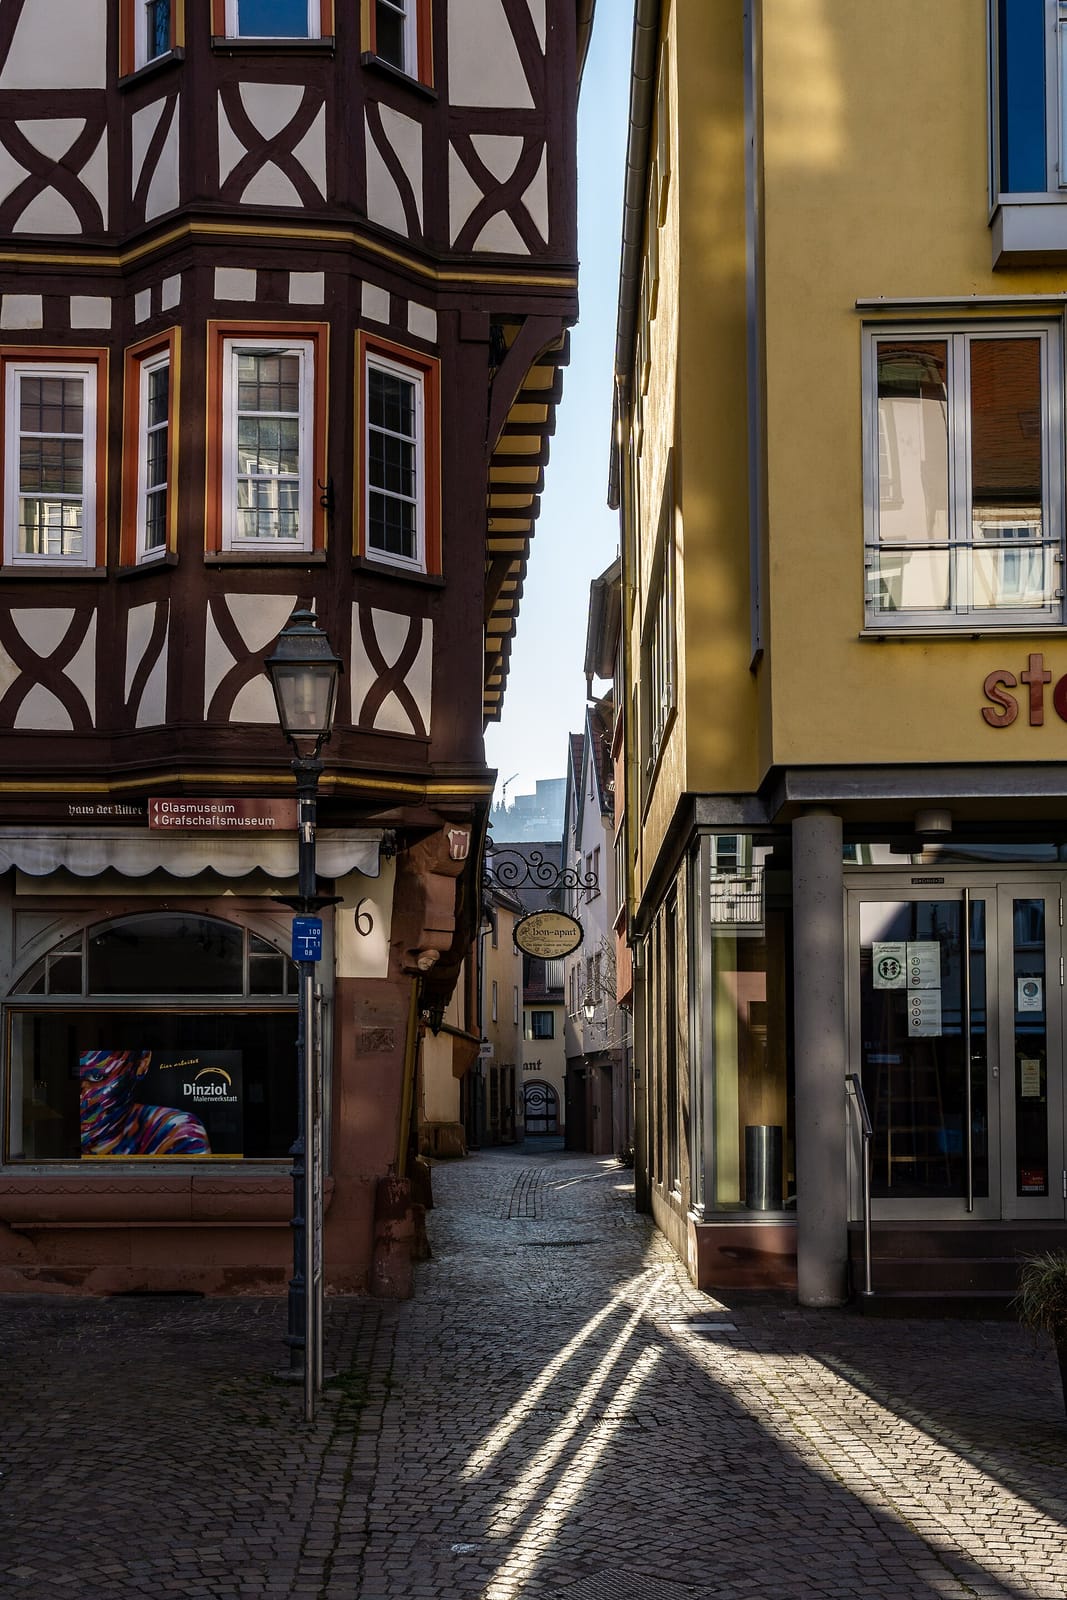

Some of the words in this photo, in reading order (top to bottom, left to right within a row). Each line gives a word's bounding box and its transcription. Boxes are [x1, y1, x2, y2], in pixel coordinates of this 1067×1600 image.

[96, 804, 113, 814] der
[114, 804, 143, 815] Ritter
[161, 802, 235, 813] Glasmuseum
[161, 815, 275, 826] Grafschaftsmuseum
[355, 897, 374, 937] 6
[532, 928, 577, 938] bon-apart
[183, 1082, 227, 1096] Dinziol
[193, 1095, 238, 1103] Malerwerkstatt
